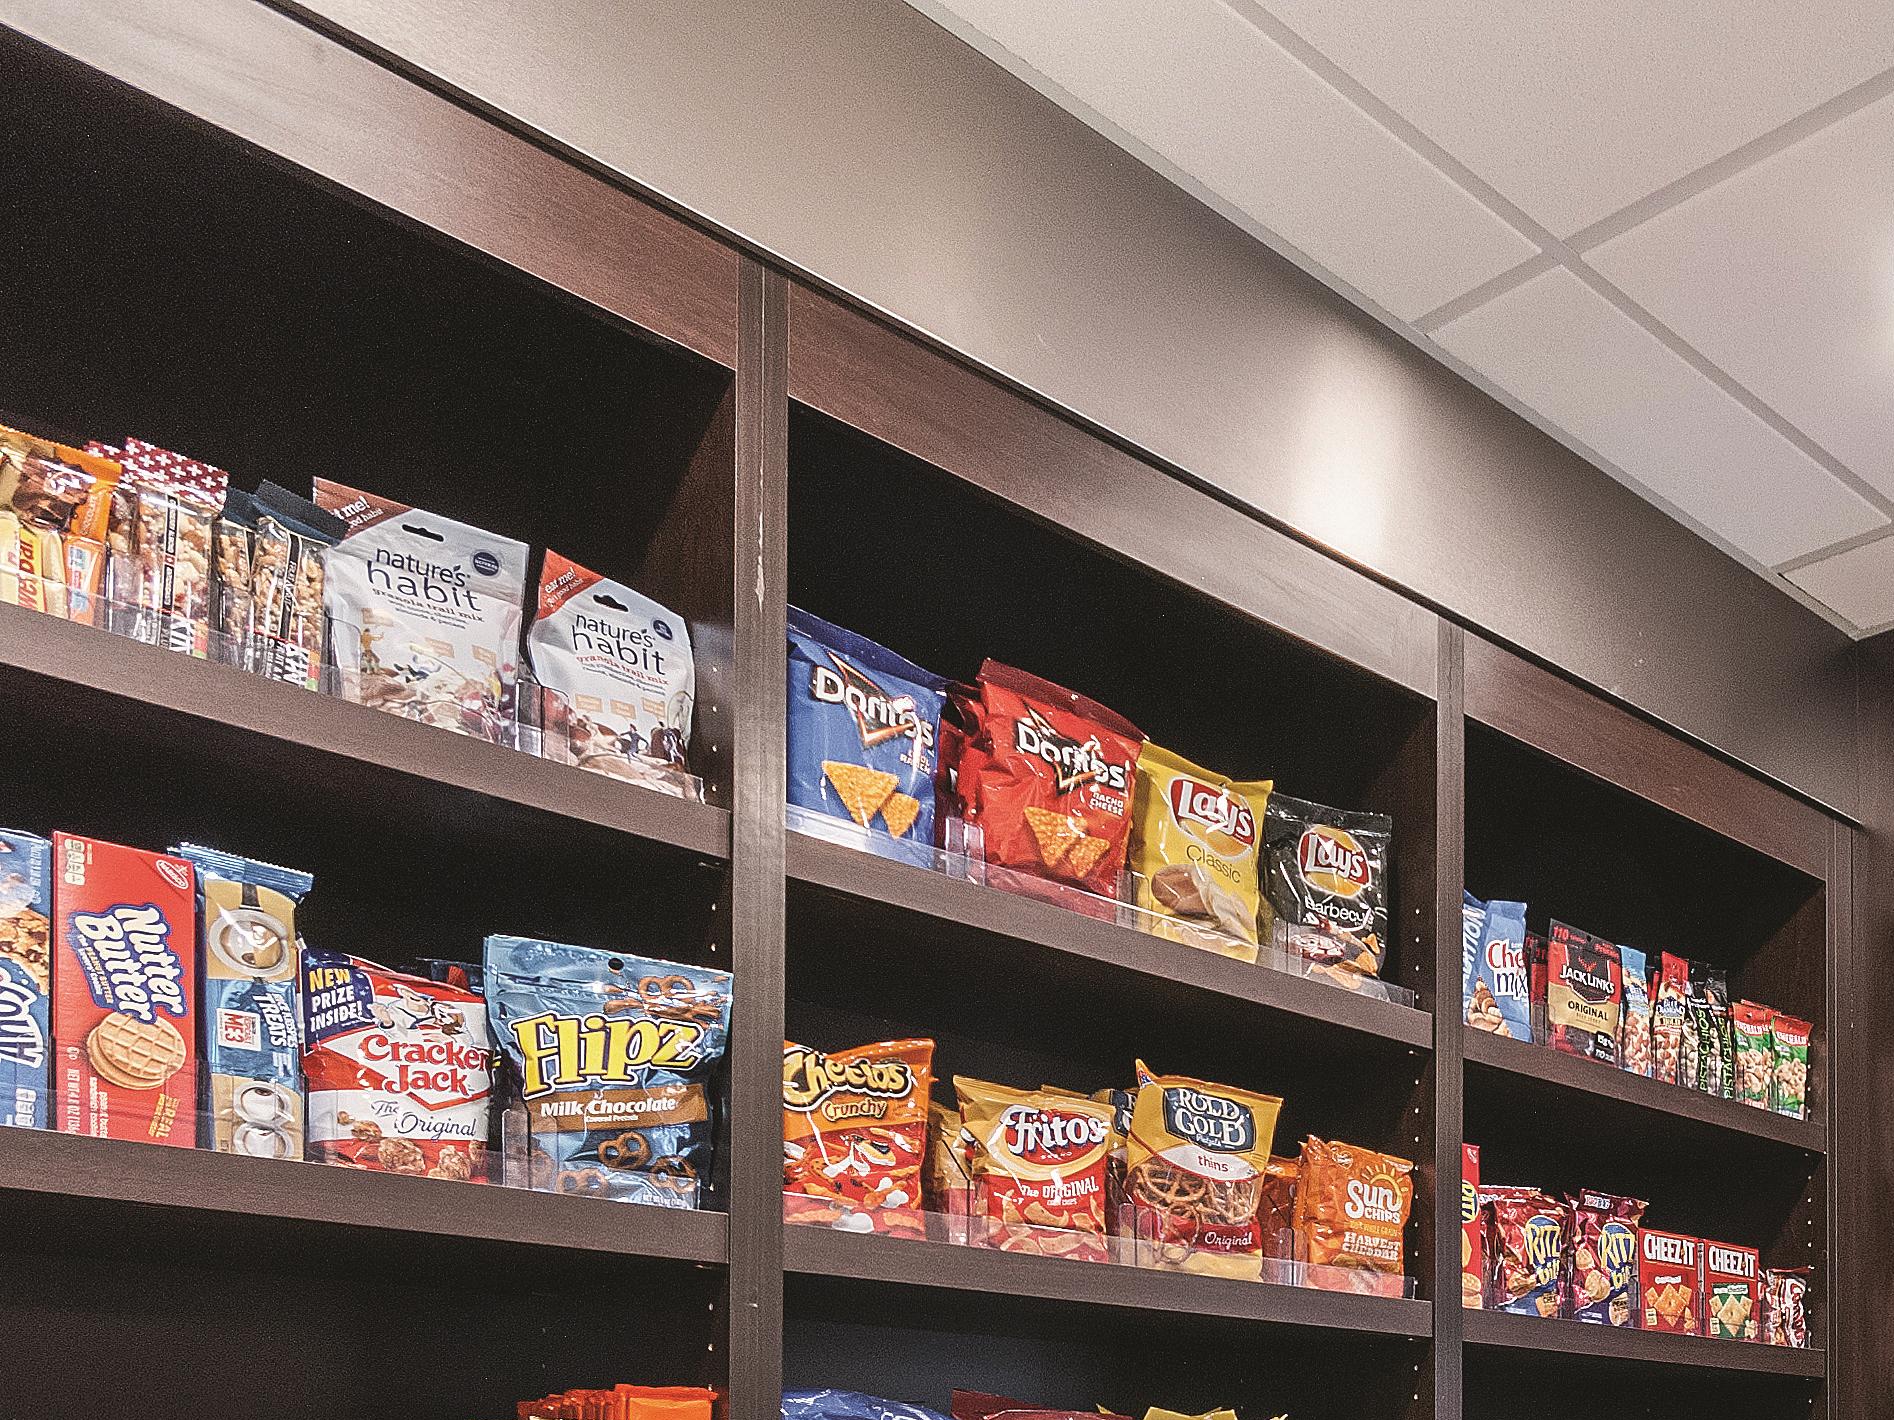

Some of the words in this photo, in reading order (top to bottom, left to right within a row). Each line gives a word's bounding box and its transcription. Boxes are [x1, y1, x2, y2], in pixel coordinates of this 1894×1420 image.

[375, 548, 470, 587] nature's
[366, 560, 482, 612] habit
[426, 600, 454, 615] trail
[459, 611, 485, 622] mix
[576, 614, 655, 648] nature's
[571, 625, 665, 675] habit
[814, 665, 934, 748] Doritos
[1186, 844, 1241, 884] Classic
[75, 914, 154, 1022] Butter
[114, 906, 186, 1016] Nutter
[1560, 965, 1588, 985] JACK
[309, 967, 351, 992] NEW
[311, 986, 356, 1013] PRIZE
[1567, 1000, 1609, 1021] ORIGINAL
[253, 991, 287, 1048] TREATS
[310, 1002, 364, 1031] INSIDE!
[358, 1034, 491, 1071] Cracker
[512, 1014, 701, 1098] Flipz
[1699, 1009, 1711, 1092] PISTACHIOS
[1717, 1017, 1734, 1099] PISTACHIOS
[383, 1063, 470, 1095] Jack
[783, 1051, 906, 1101] Cheetos
[371, 1099, 400, 1117] The
[540, 1099, 584, 1117] Milk
[588, 1096, 678, 1116] Chocolate
[823, 1098, 887, 1120] Crunchy
[1178, 1088, 1241, 1121] ROLD
[395, 1109, 478, 1140] Original
[1008, 1107, 1109, 1153] Fritos
[1174, 1110, 1247, 1147] GOLD
[1198, 1153, 1229, 1173] thins
[1020, 1183, 1039, 1197] The
[1344, 1180, 1402, 1219] Sun
[1364, 1206, 1402, 1224] CHIPS
[1205, 1231, 1252, 1249] Original
[1342, 1243, 1399, 1262] CHEDDAR
[1343, 1231, 1401, 1251] HARVEST
